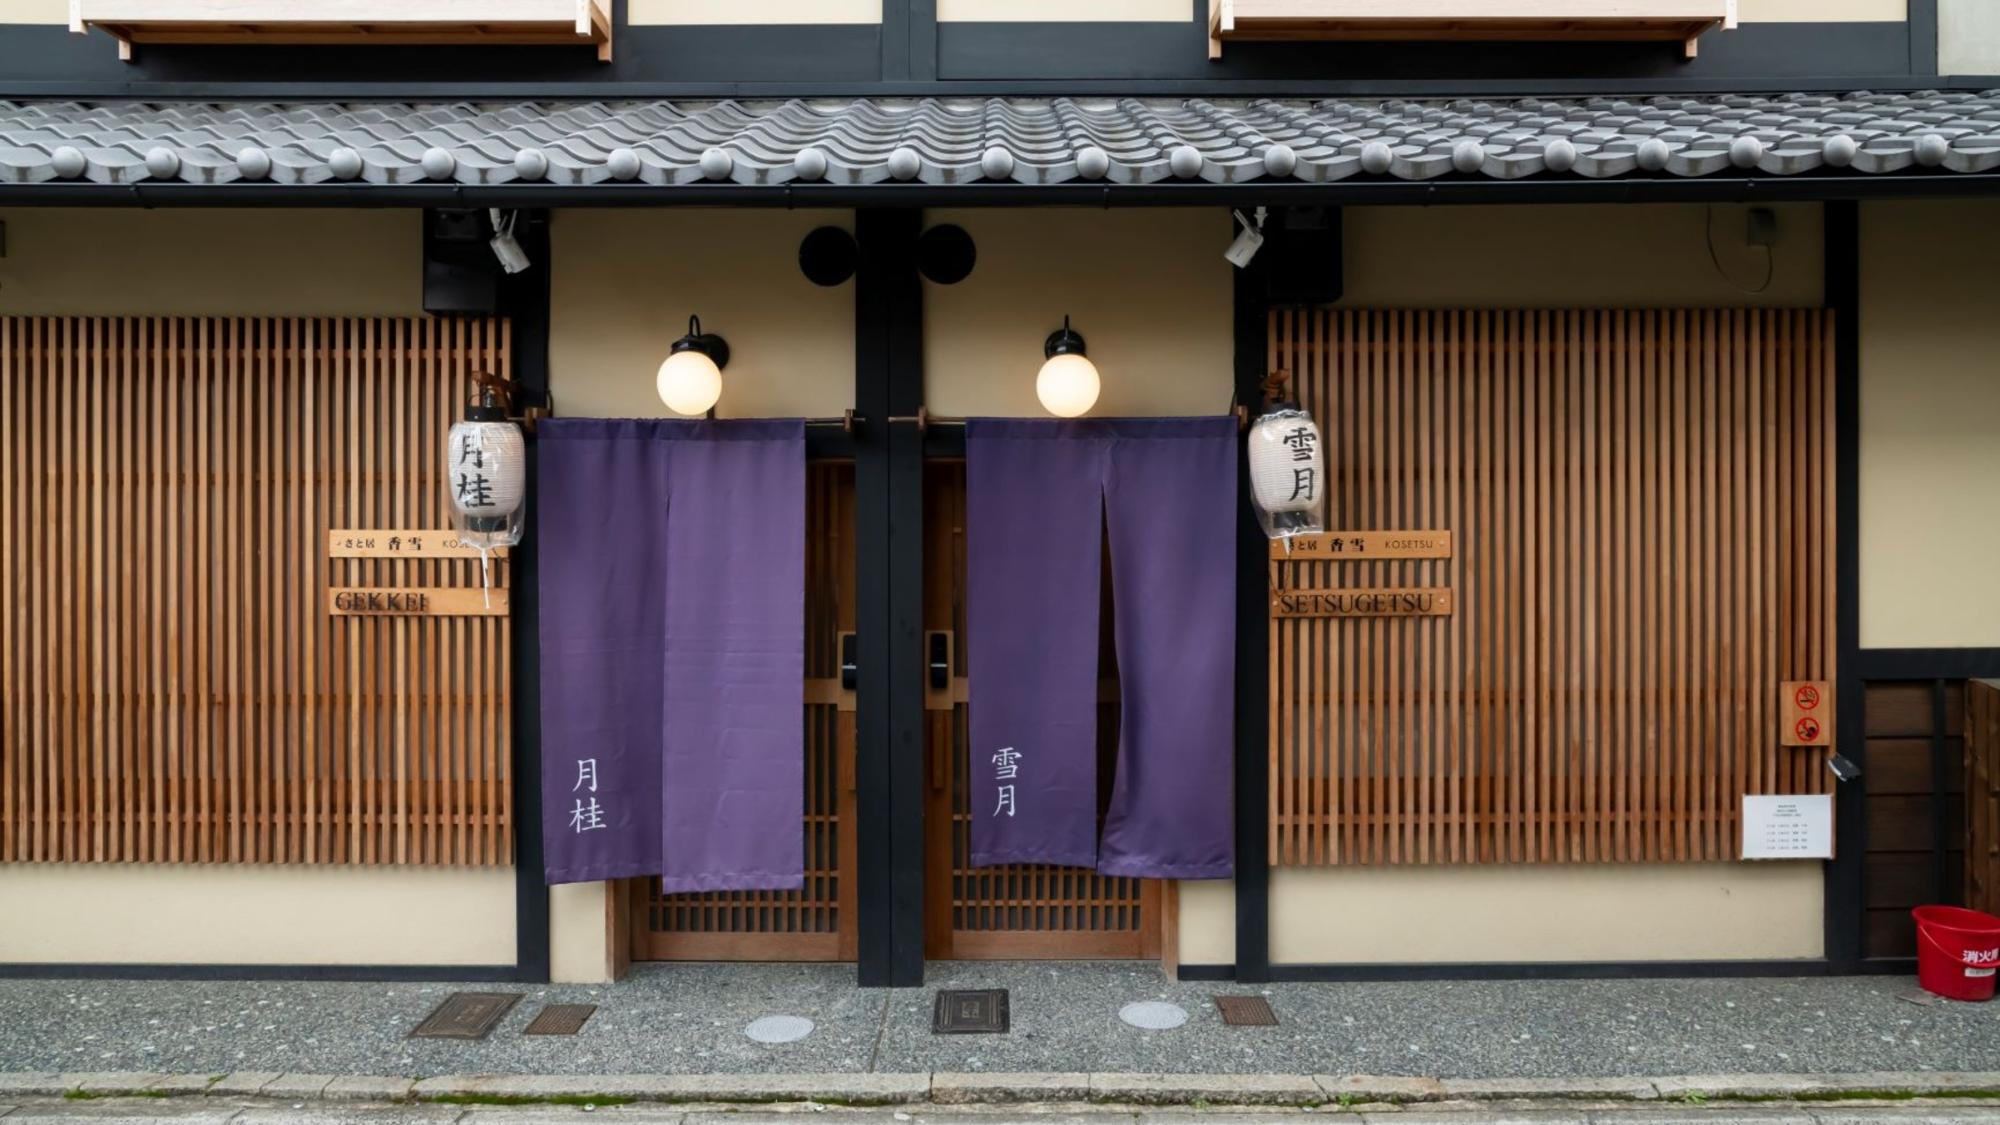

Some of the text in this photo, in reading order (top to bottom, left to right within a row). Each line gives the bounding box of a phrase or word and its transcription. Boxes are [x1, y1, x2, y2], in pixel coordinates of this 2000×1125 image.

[456, 433, 496, 508] 月桂
[1283, 427, 1317, 502] 雪月
[388, 536, 422, 551] 香雪
[1331, 538, 1364, 552] 香雪
[1385, 539, 1433, 549] KOSETSU
[1280, 593, 1433, 614] SETSUGETSU
[568, 758, 607, 834] 月桂
[991, 746, 1023, 818] 雪月
